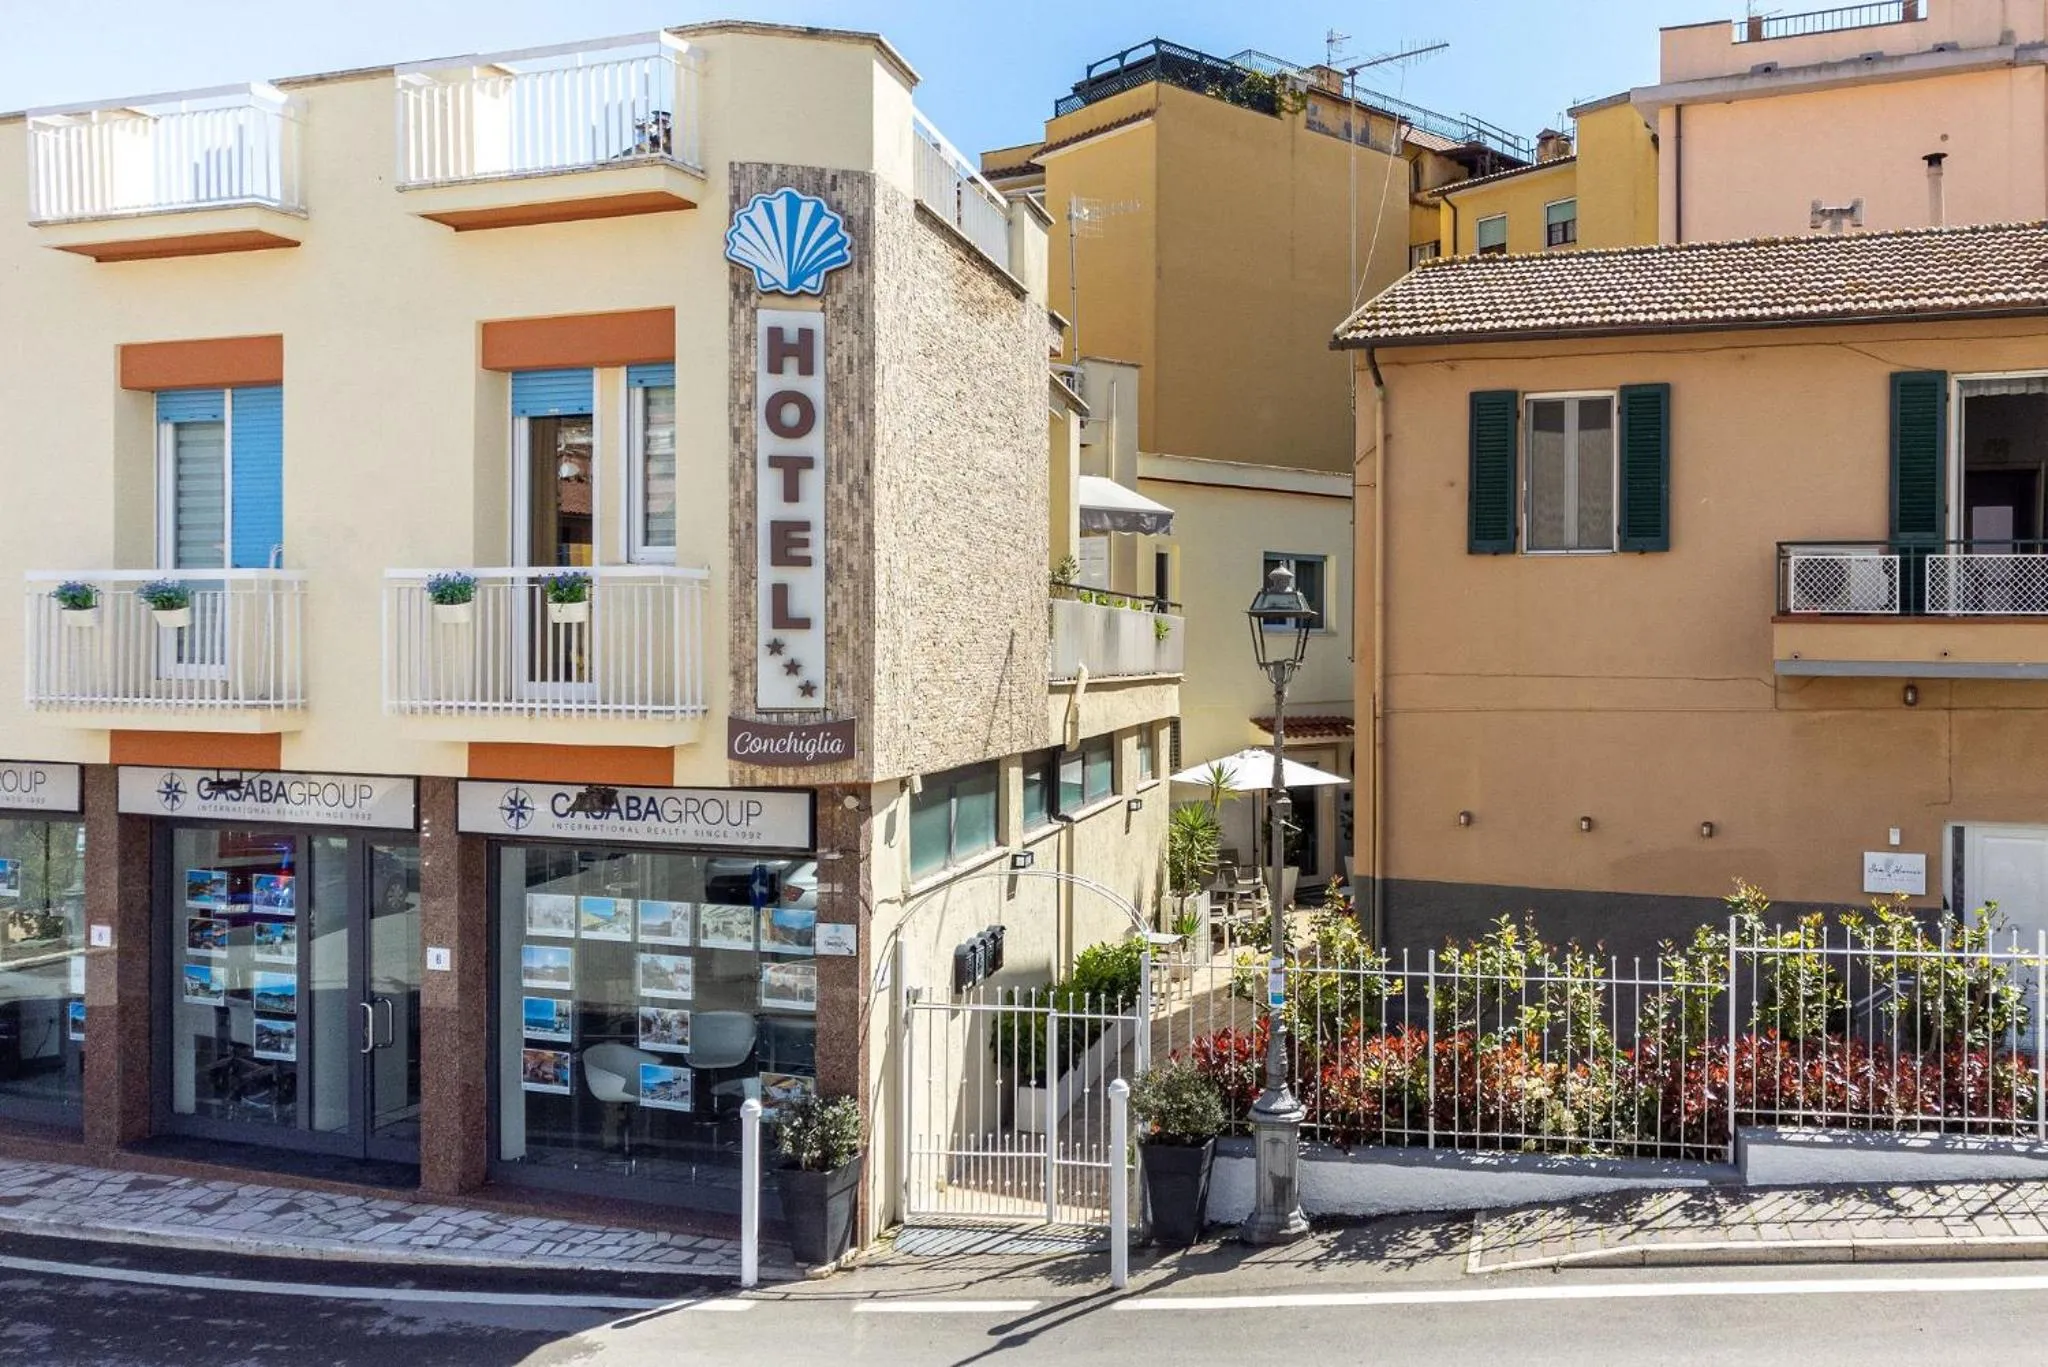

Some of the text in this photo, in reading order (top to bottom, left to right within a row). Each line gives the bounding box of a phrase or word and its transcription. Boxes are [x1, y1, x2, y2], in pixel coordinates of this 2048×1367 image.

[765, 326, 816, 630] HOTEL
[734, 731, 846, 761] Conchiglia
[0, 769, 46, 793] OUP
[551, 823, 762, 840] INTERNATIONAL REALTY SINCE 1992
